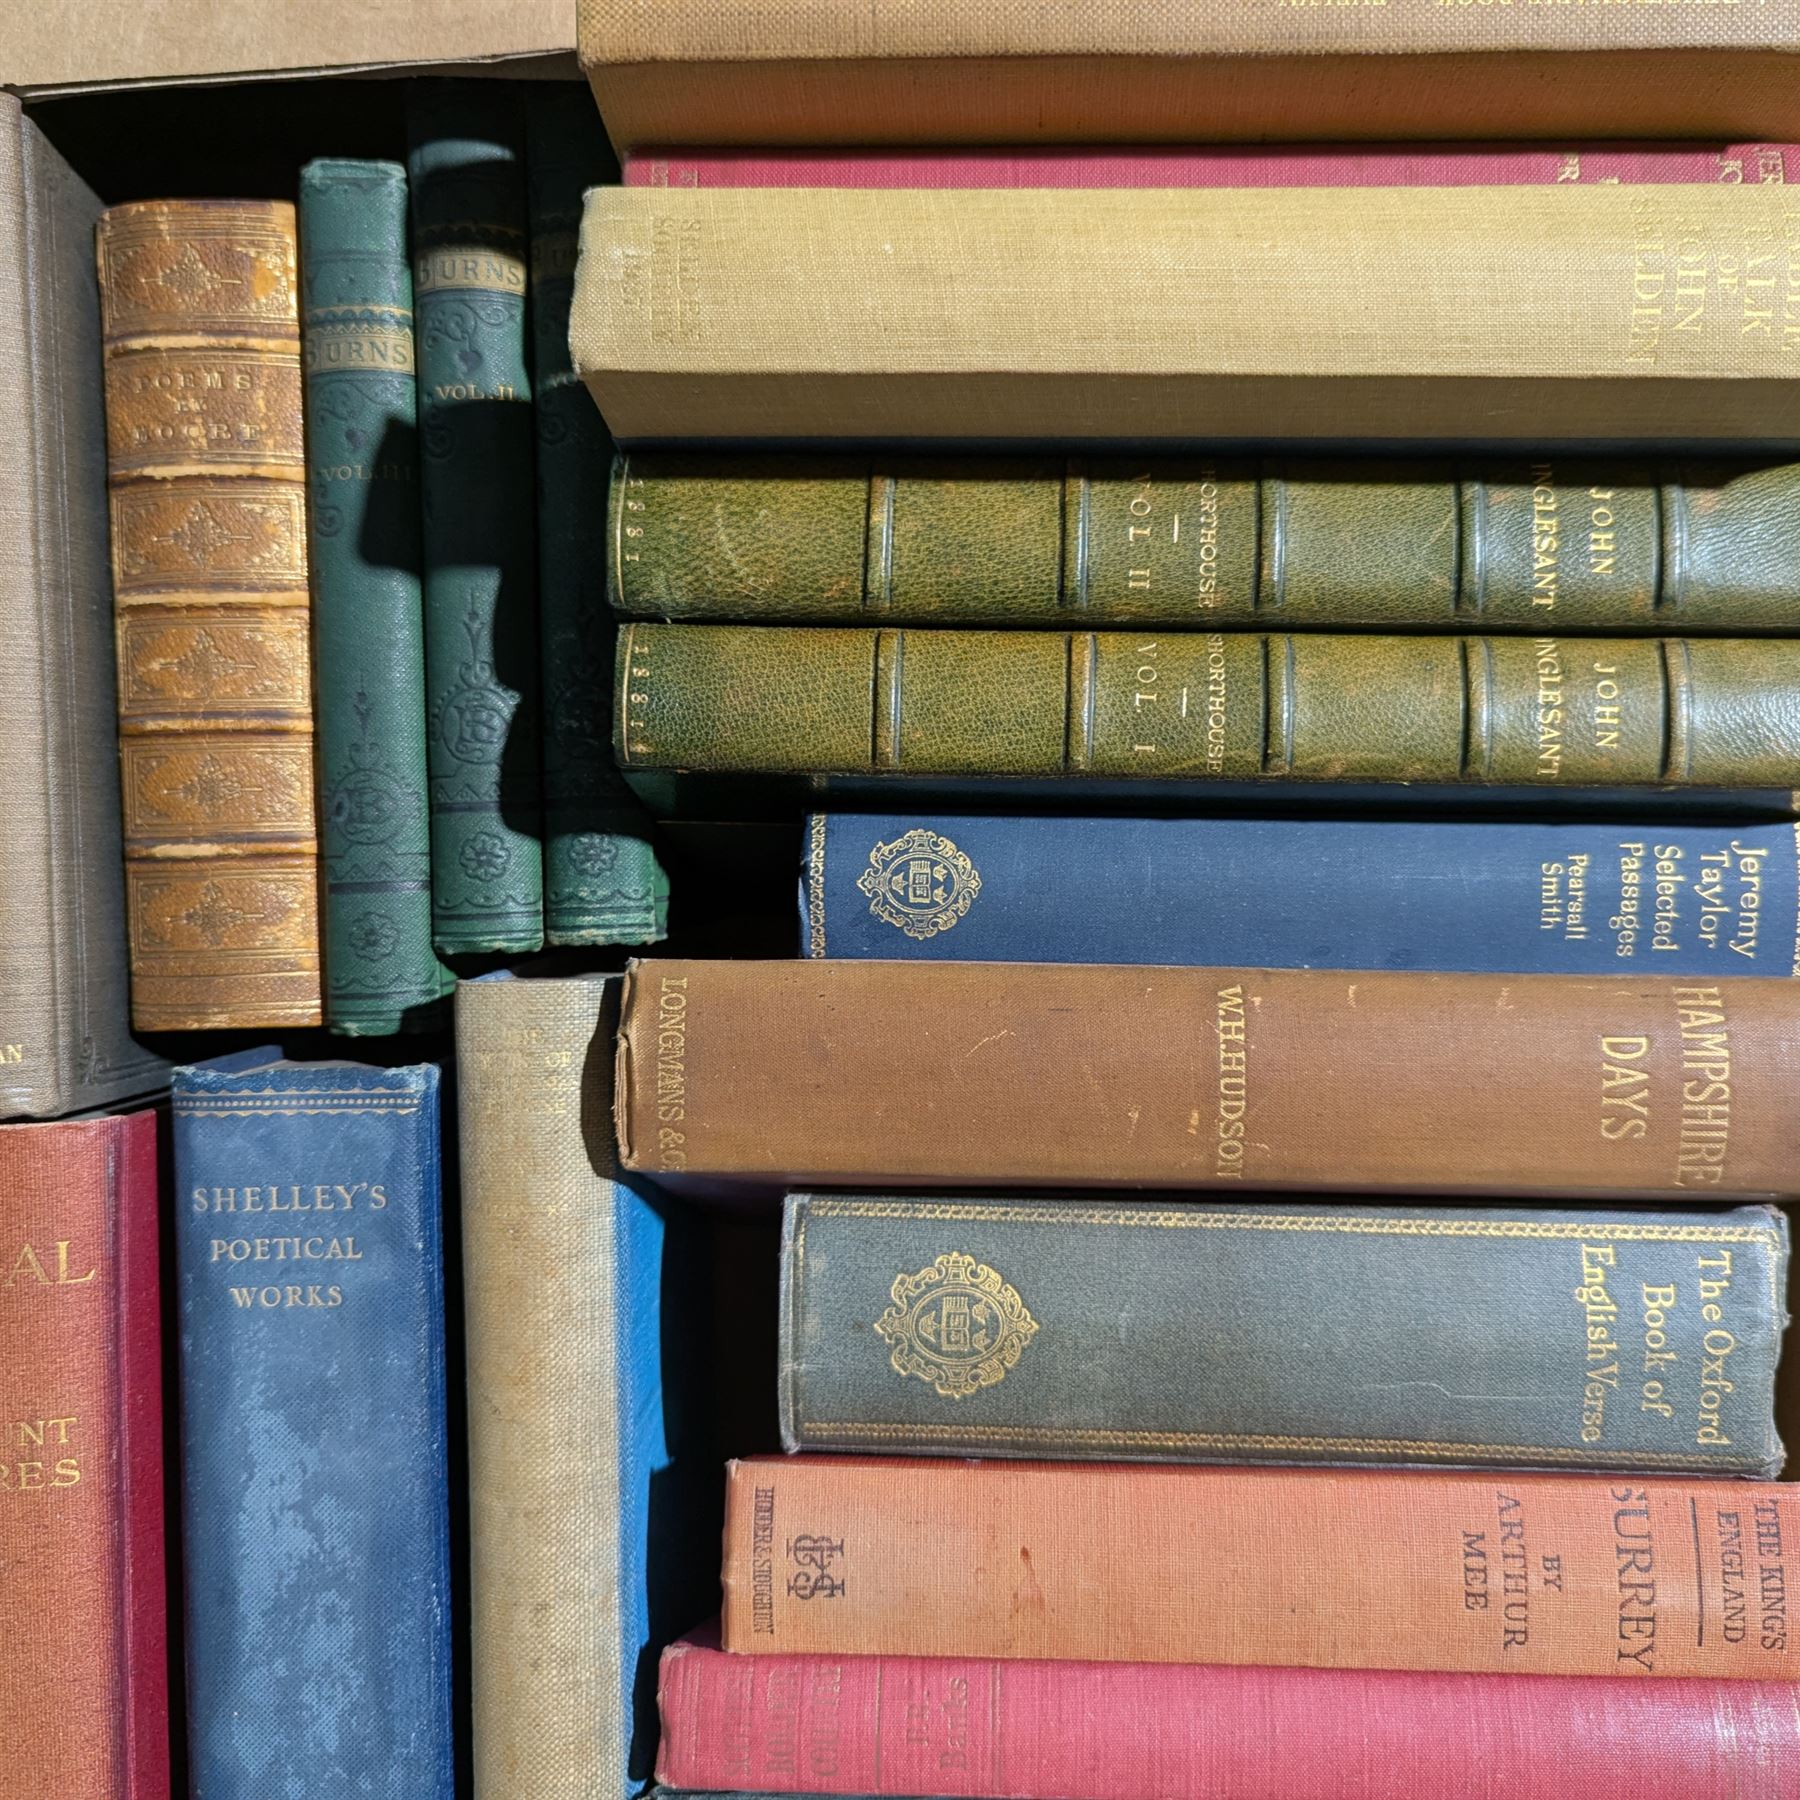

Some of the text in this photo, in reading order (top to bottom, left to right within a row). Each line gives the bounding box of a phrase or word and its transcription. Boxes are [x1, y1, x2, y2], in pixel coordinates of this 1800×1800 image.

[1717, 254, 1738, 294] OF
[135, 371, 252, 394] POEMS
[1129, 567, 1150, 589] II
[1589, 486, 1615, 575] JOHN
[1135, 642, 1157, 713] VOL.
[1206, 633, 1226, 774] SHORTHOUSE
[1593, 662, 1619, 750] JOHN
[1540, 862, 1565, 930] Smith
[1564, 853, 1591, 941] Pearsall
[1609, 843, 1646, 957] Passages
[1652, 845, 1688, 951] Selected
[1693, 850, 1733, 949] Taylor
[1728, 840, 1768, 959] Jeremy
[656, 976, 688, 1122] LONGMANS
[1600, 1036, 1649, 1140] DAYS
[1672, 986, 1731, 1187] HAMPSHIRE
[192, 1182, 387, 1213] SHELLEY'S
[210, 1237, 364, 1262] POETICAL
[229, 1285, 343, 1309] WORKS
[1575, 1243, 1619, 1444] English Verse
[1641, 1282, 1678, 1419] Book of
[1697, 1249, 1736, 1446] The Oxford
[1462, 1530, 1488, 1611] MEE
[1496, 1491, 1530, 1650] ARTHUR
[1542, 1554, 1562, 1593] BY
[1611, 1487, 1657, 1672] SURREY
[1717, 1510, 1746, 1645] ENGLAND
[1754, 1498, 1787, 1651] THE KING'S
